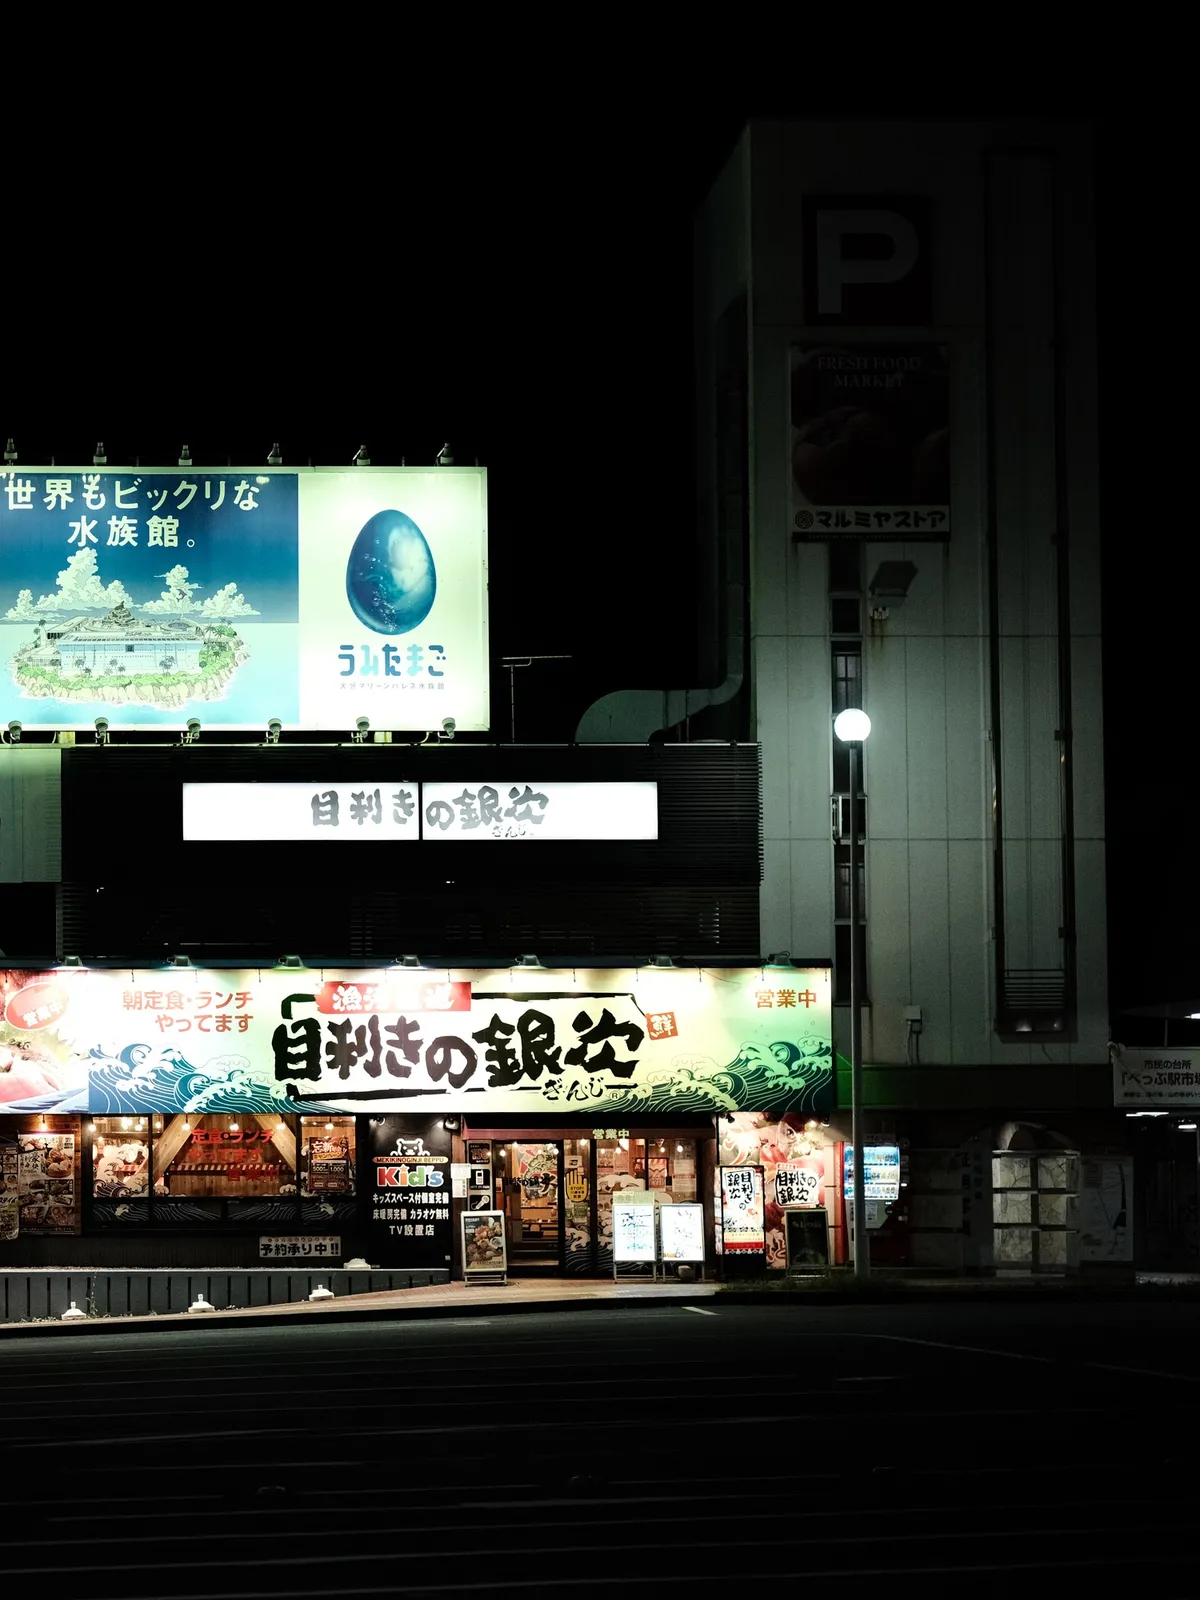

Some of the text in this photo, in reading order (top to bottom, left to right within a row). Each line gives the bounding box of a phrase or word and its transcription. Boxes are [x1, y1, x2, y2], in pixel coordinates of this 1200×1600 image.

[816, 208, 920, 315] P
[817, 356, 922, 372] FRESH FOOD
[834, 373, 906, 389] MARKET
[4, 478, 260, 511] 世界もビックリな
[816, 510, 946, 529] マルミヤストア
[68, 515, 196, 548] 水族館。
[337, 643, 447, 677] うみたまご
[311, 785, 549, 831] 目利きの銀次
[122, 990, 253, 1010] 朝定食・ランチ
[754, 989, 818, 1009] 営業中
[155, 1014, 254, 1032] やってます
[272, 1008, 644, 1089] 目利きの銀次
[1144, 1059, 1191, 1070] 市民の台所
[542, 1077, 604, 1101] ぎんじ
[191, 1129, 274, 1143] 定食・ランチ
[593, 1129, 630, 1139] 営業中
[377, 1163, 444, 1187] Kid's
[779, 1171, 817, 1188] 目利きの
[373, 1192, 449, 1204] キッズスペース付個室完備
[779, 1187, 809, 1205] 銀次
[410, 1208, 449, 1220] カラオケ無料
[389, 1224, 435, 1236] TV設置店
